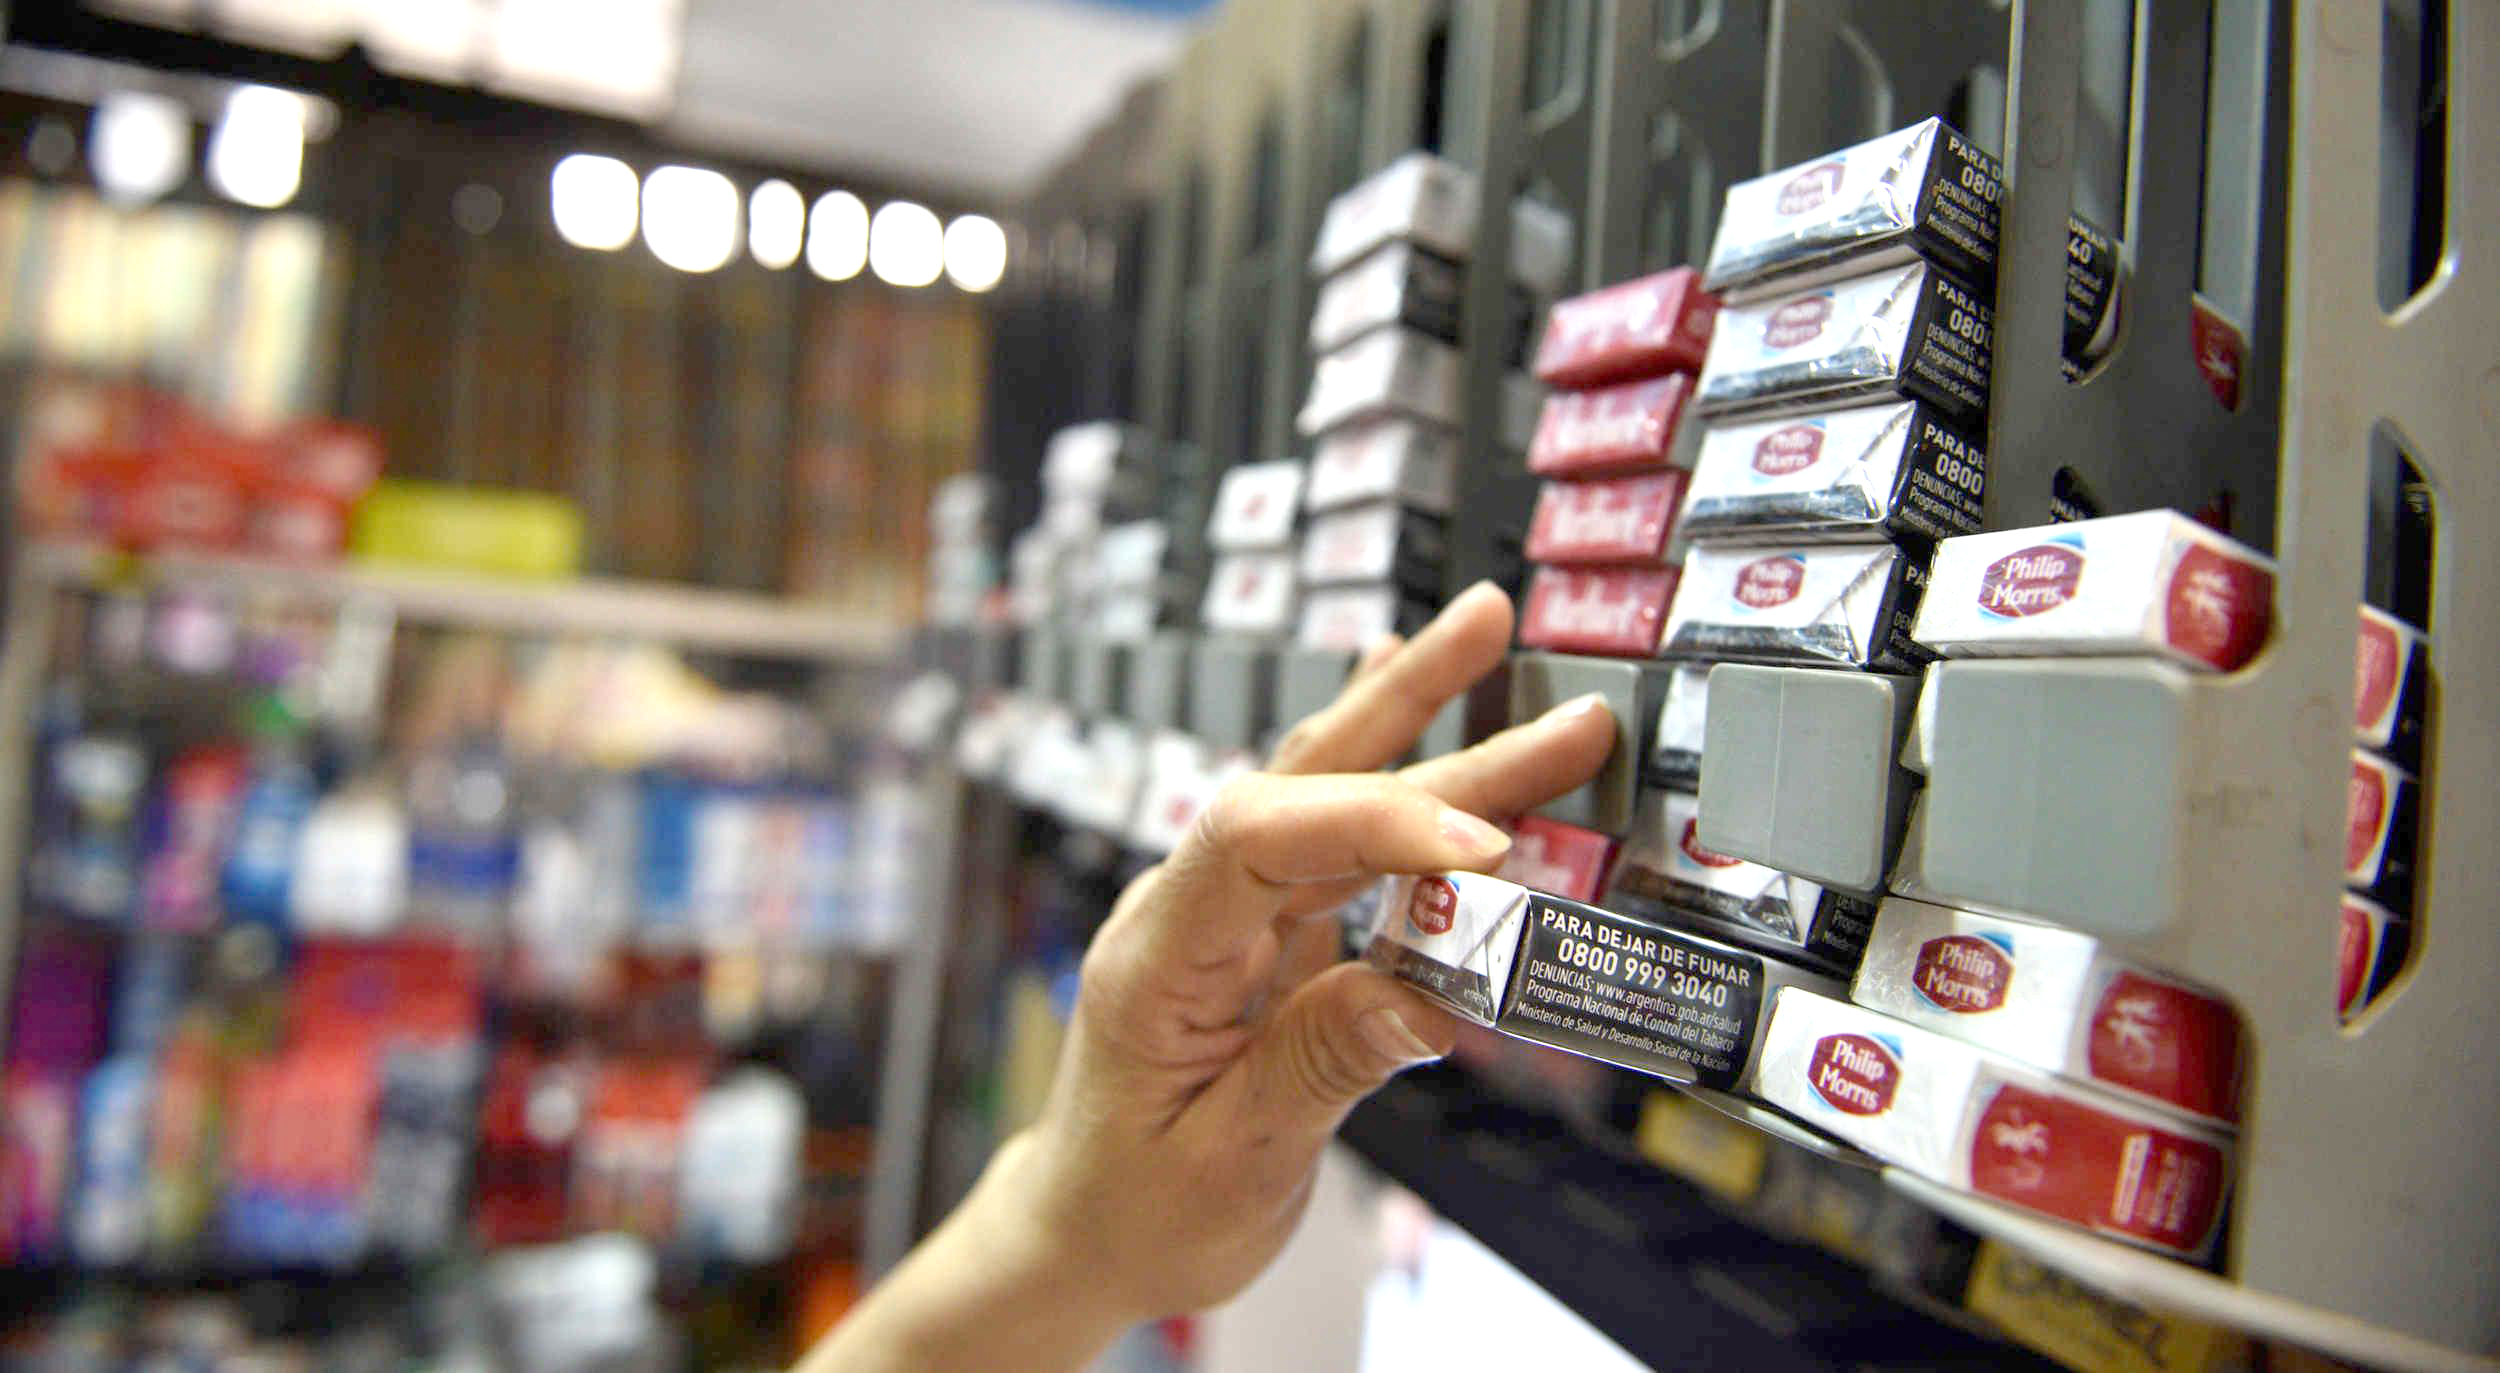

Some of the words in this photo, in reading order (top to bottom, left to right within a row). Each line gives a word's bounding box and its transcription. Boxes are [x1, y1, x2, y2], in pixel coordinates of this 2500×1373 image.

[1947, 135, 1989, 174] PARA
[2067, 237, 2093, 265] 40
[1937, 279, 1978, 315] PARA
[1924, 423, 1966, 459] PARA
[1936, 453, 1984, 497] 0800
[2004, 554, 2066, 580] Philip
[1990, 582, 2061, 607] Morris
[1542, 908, 1593, 940] PARA
[1597, 925, 1656, 960] DEJAR
[1661, 944, 1685, 968] DE
[1687, 953, 1751, 987] FUMAR
[1938, 940, 1996, 979] Philip
[1558, 938, 1618, 976] 0800
[1625, 957, 1666, 989] 999
[1671, 971, 1727, 1008] 3040
[1924, 965, 1990, 1009] Morris
[1526, 979, 1581, 1009] Programa
[1582, 995, 1629, 1022] Nacional
[1629, 1007, 1642, 1026] de
[1645, 1012, 1681, 1039] Control
[1681, 1024, 1700, 1042] del
[1702, 1029, 1736, 1054] Tabaco
[1530, 959, 1596, 993] DENUNCIAS:
[1596, 981, 1742, 1035] www.argentina.gob.ar/salud
[1516, 1001, 1562, 1028] Ministerio
[1562, 1015, 1575, 1030] de
[1575, 1018, 1603, 1037] Salud
[1600, 1026, 1610, 1040] y
[1832, 1039, 1886, 1082] Philip
[1818, 1063, 1880, 1111] Morris
